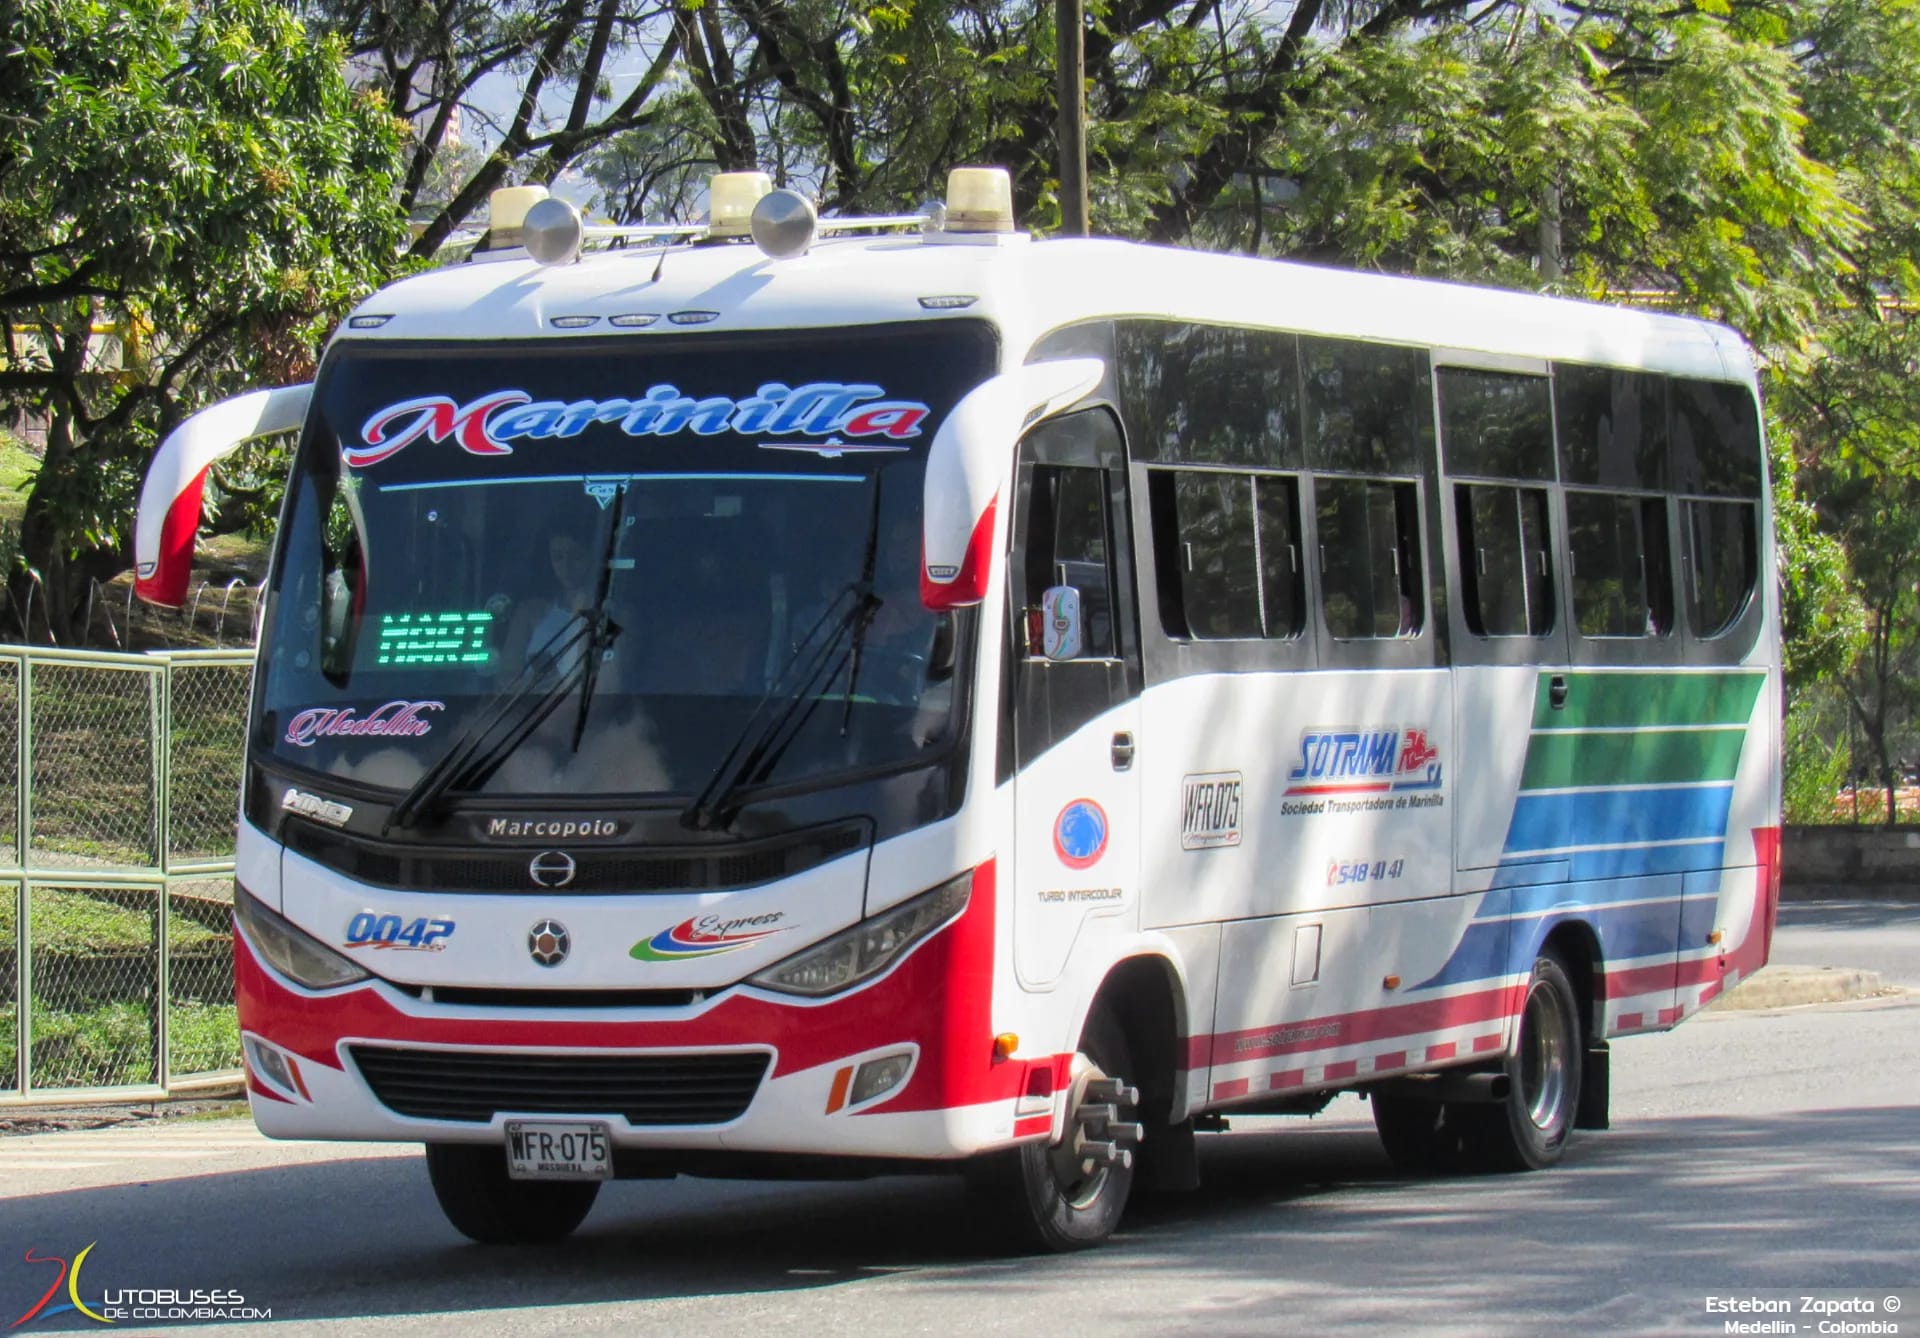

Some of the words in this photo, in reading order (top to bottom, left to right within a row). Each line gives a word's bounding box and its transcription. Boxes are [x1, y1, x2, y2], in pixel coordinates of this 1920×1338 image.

[344, 384, 929, 467] Marinilla
[285, 701, 446, 747] Medellin
[1183, 784, 1214, 832] WFR
[1213, 781, 1240, 829] 075
[1281, 801, 1324, 816] Sociedad
[1328, 797, 1393, 814] Transportadora
[1395, 797, 1407, 809] de
[1409, 794, 1444, 808] Marinilla
[489, 818, 617, 837] Marcopolo
[1337, 863, 1369, 885] 548
[1370, 861, 1386, 880] 41
[1388, 859, 1404, 879] 41
[1038, 891, 1066, 902] TURBO
[1067, 887, 1122, 901] INTERCOOLER
[346, 912, 456, 947] 0042
[690, 910, 784, 941] Express
